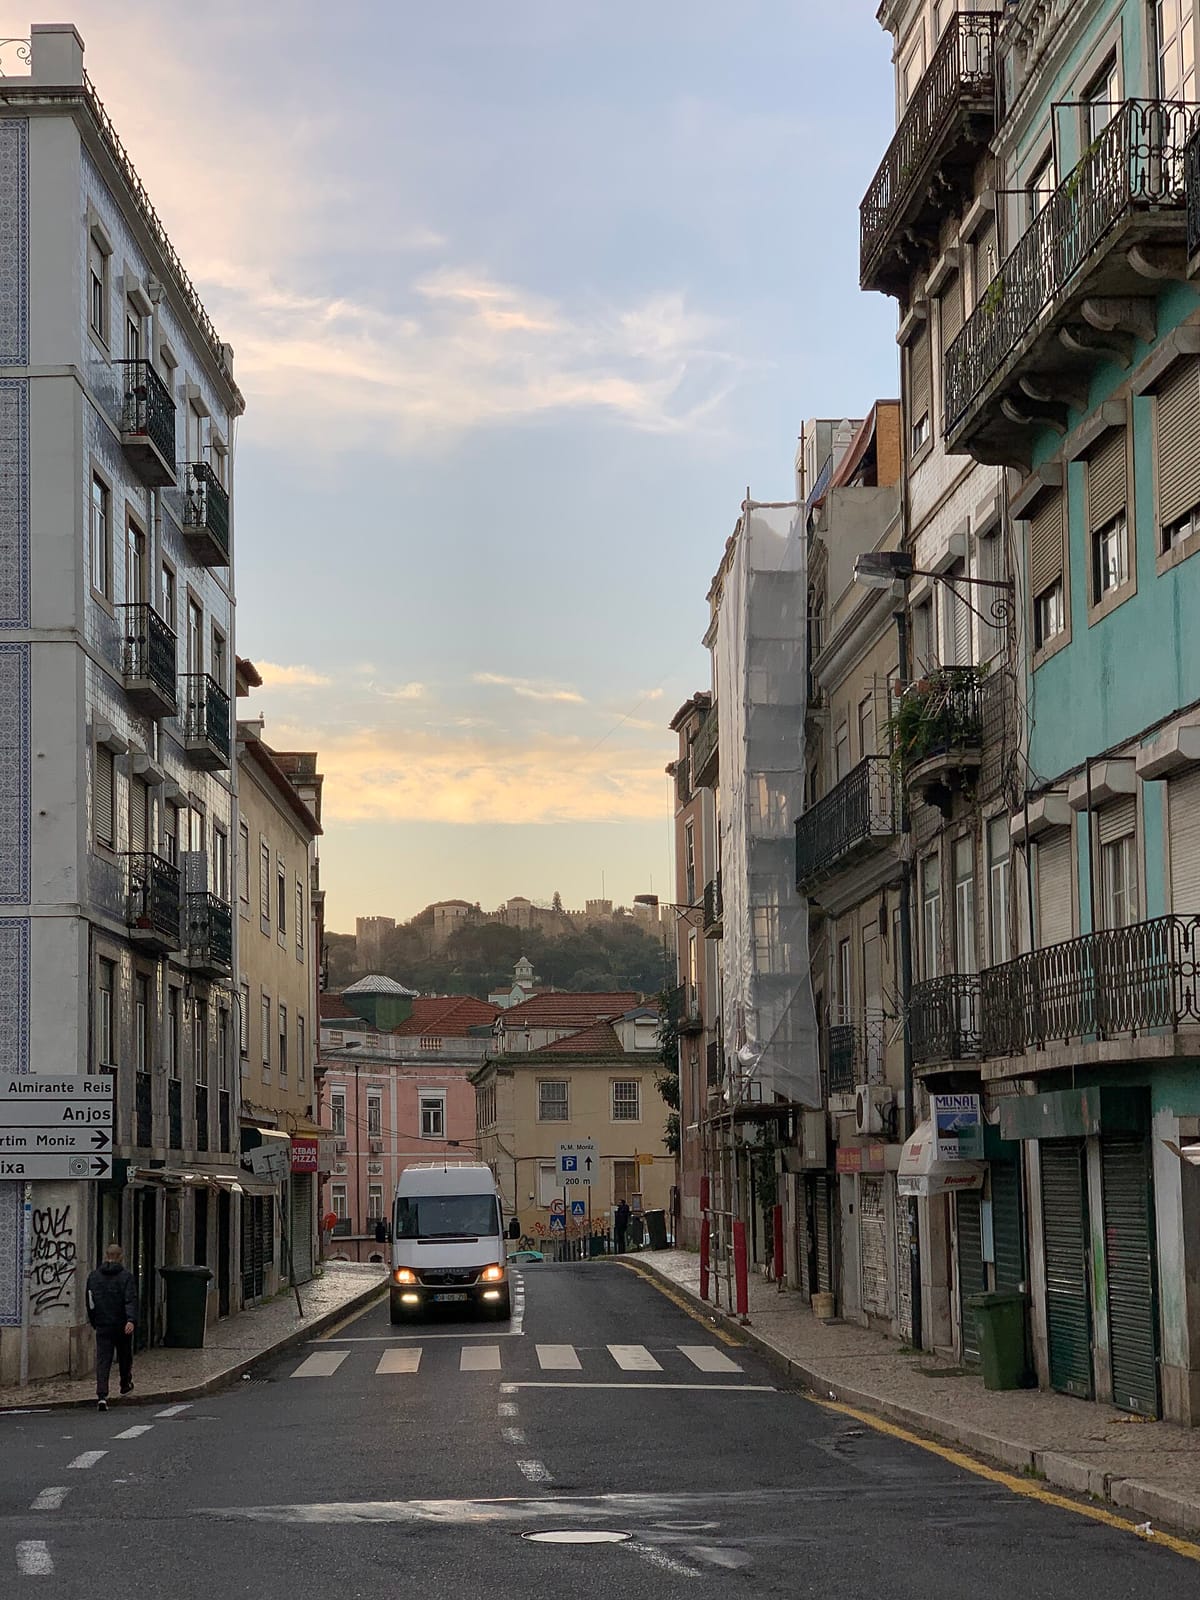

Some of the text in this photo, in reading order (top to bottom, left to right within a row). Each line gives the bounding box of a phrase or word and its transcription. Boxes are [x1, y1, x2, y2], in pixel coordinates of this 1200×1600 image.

[8, 1082, 112, 1093] Almirante Reis
[935, 1095, 977, 1107] MUNAL
[62, 1107, 111, 1124] Anjos
[36, 1135, 76, 1146] Moniz
[292, 1147, 317, 1155] KEBAB
[292, 1155, 317, 1163] PIZZA
